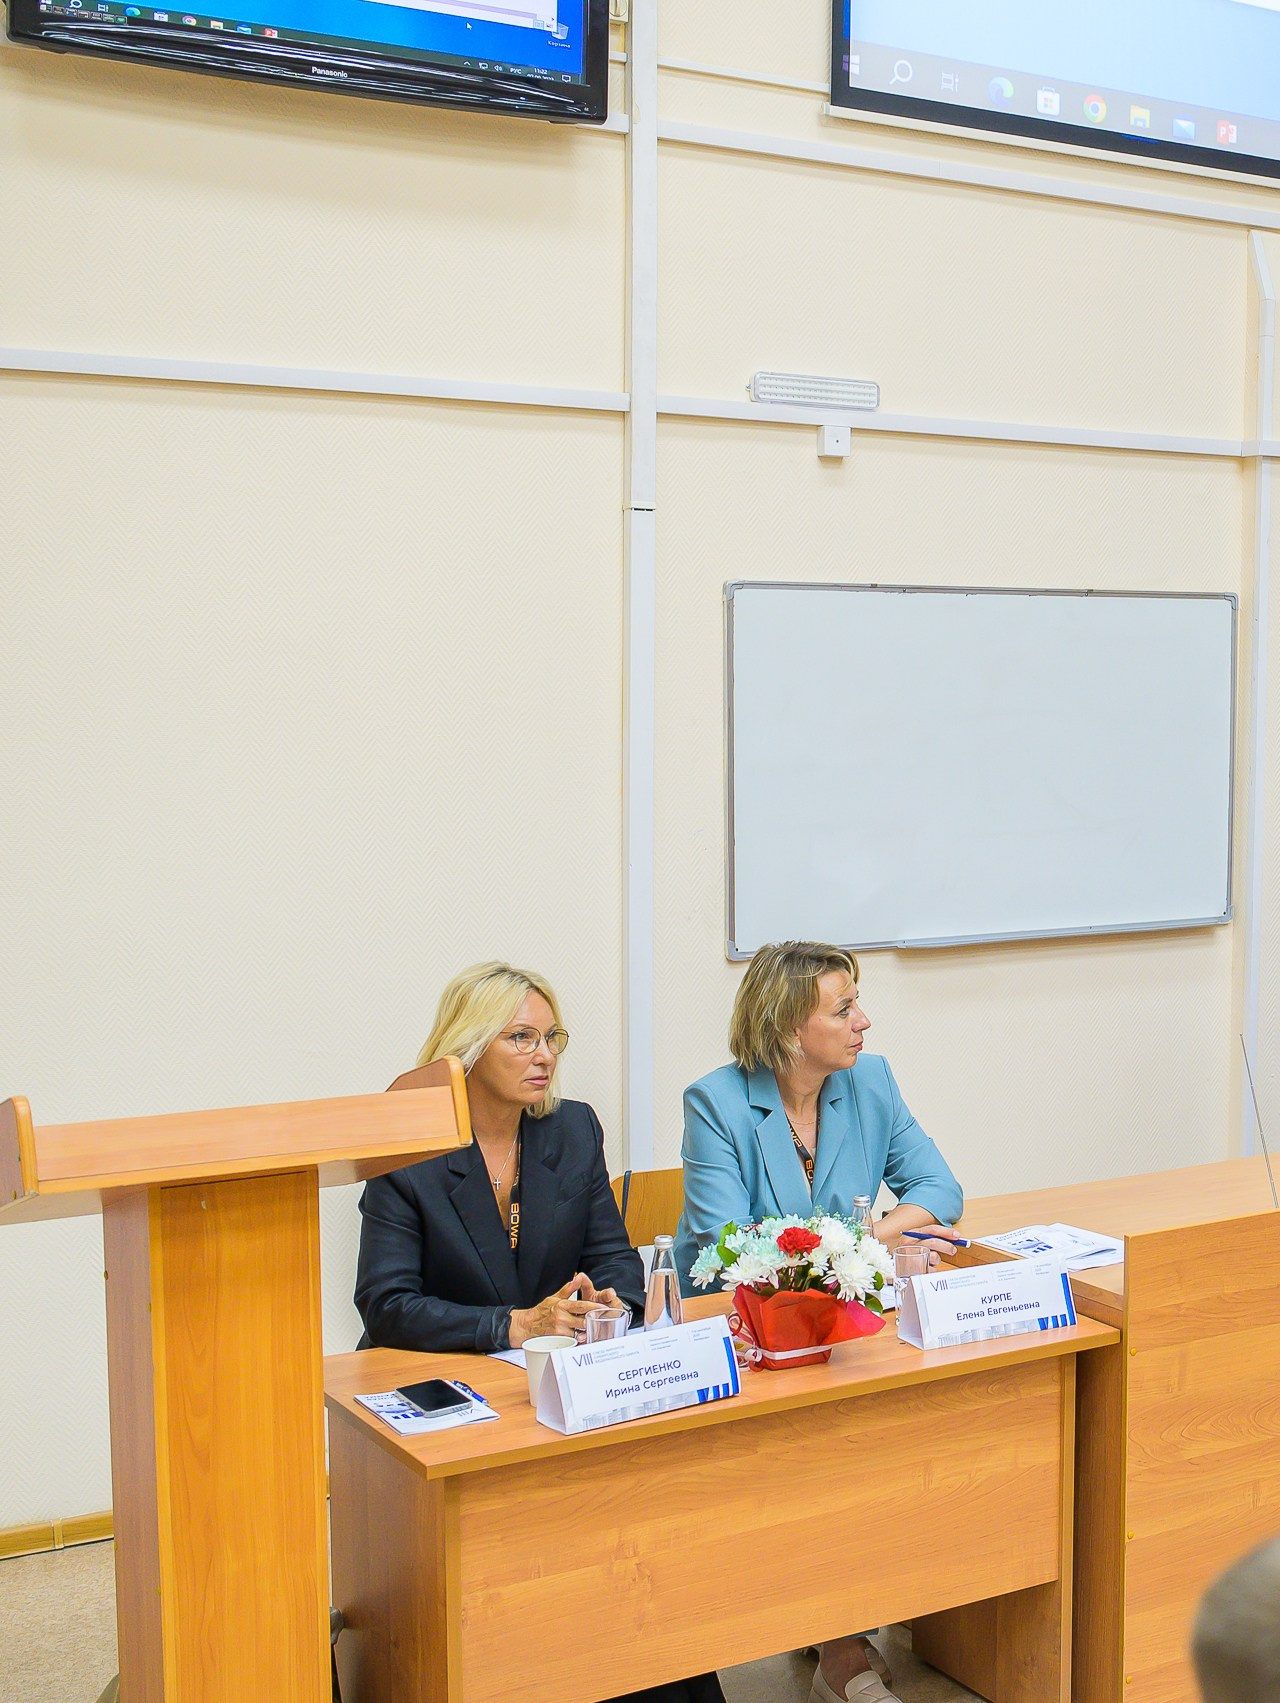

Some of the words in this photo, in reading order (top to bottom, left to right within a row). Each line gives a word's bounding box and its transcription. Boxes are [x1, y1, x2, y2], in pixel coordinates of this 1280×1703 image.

[311, 66, 348, 78] Panasonic
[930, 1278, 948, 1292] VIII
[981, 1292, 1013, 1305] КУРПЕ
[956, 1309, 985, 1321] Елена
[987, 1300, 1041, 1316] Евгеньевна
[572, 1352, 594, 1368] VIII
[618, 1359, 682, 1382] СЕРГИЕНКО
[605, 1383, 641, 1399] Ирина
[643, 1370, 699, 1391] Сергеевна
